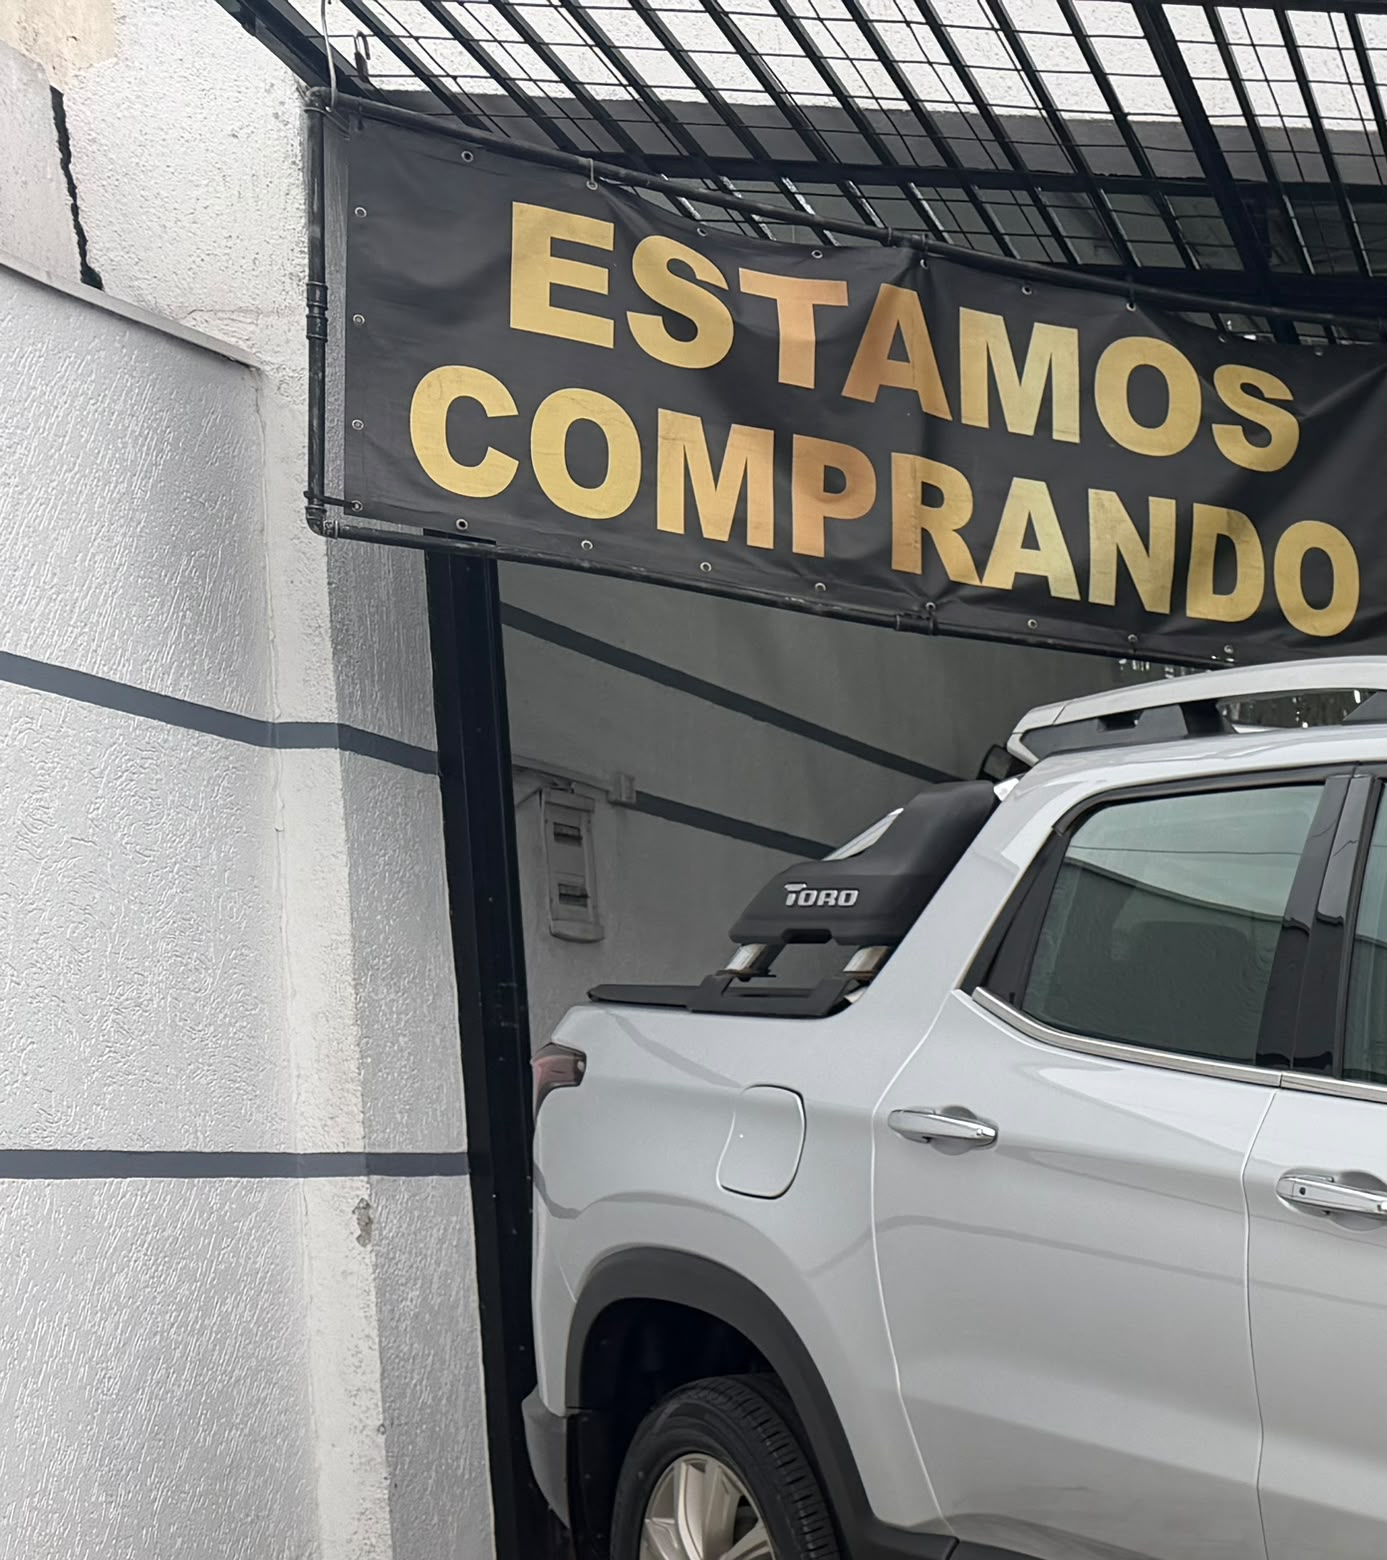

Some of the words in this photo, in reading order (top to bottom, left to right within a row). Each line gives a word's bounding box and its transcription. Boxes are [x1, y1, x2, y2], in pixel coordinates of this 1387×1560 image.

[508, 201, 1300, 473] ESTAMOS
[408, 365, 1360, 638] COMPRANDO
[783, 883, 859, 906] TORO
